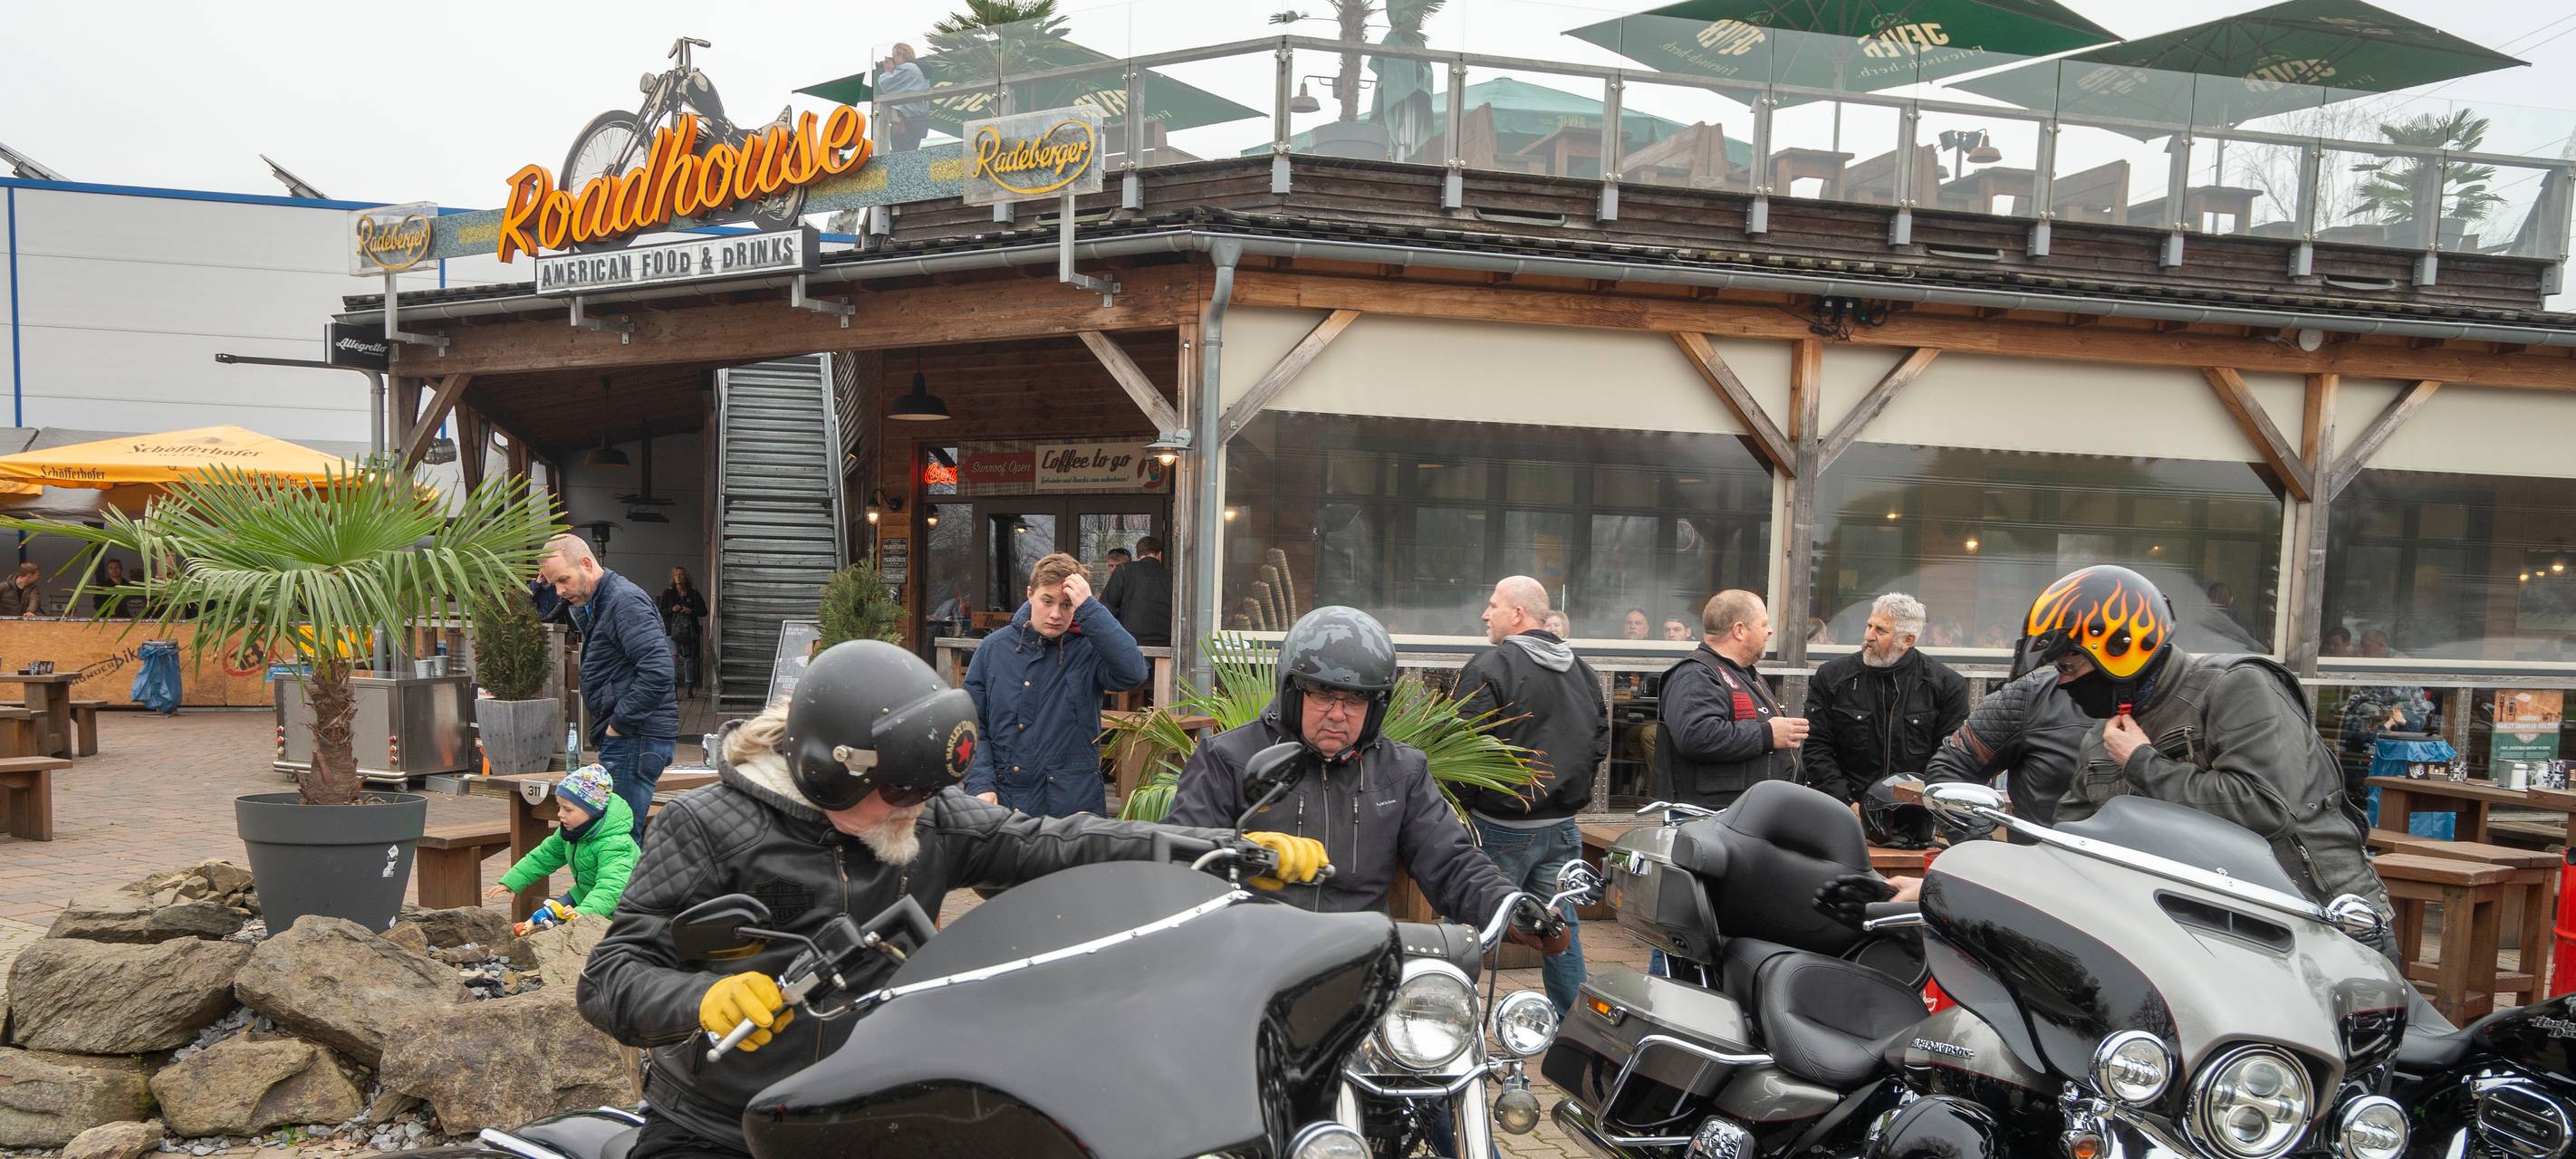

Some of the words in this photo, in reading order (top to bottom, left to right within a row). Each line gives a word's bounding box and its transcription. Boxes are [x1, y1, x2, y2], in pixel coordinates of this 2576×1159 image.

[971, 119, 1094, 188] Radeberger
[497, 104, 874, 263] Roadhouse
[356, 216, 431, 264] Radeberger
[543, 254, 632, 286] AMERICAN
[642, 247, 691, 276] FOOD
[701, 246, 713, 271] &
[723, 236, 793, 269] DRINKS
[335, 337, 389, 352] Allegretto
[972, 462, 1007, 478] Sunroof
[1008, 461, 1032, 475] Open
[1042, 449, 1091, 473] Coffee
[1091, 448, 1110, 467] to
[1110, 455, 1132, 472] go
[528, 785, 541, 797] 311
